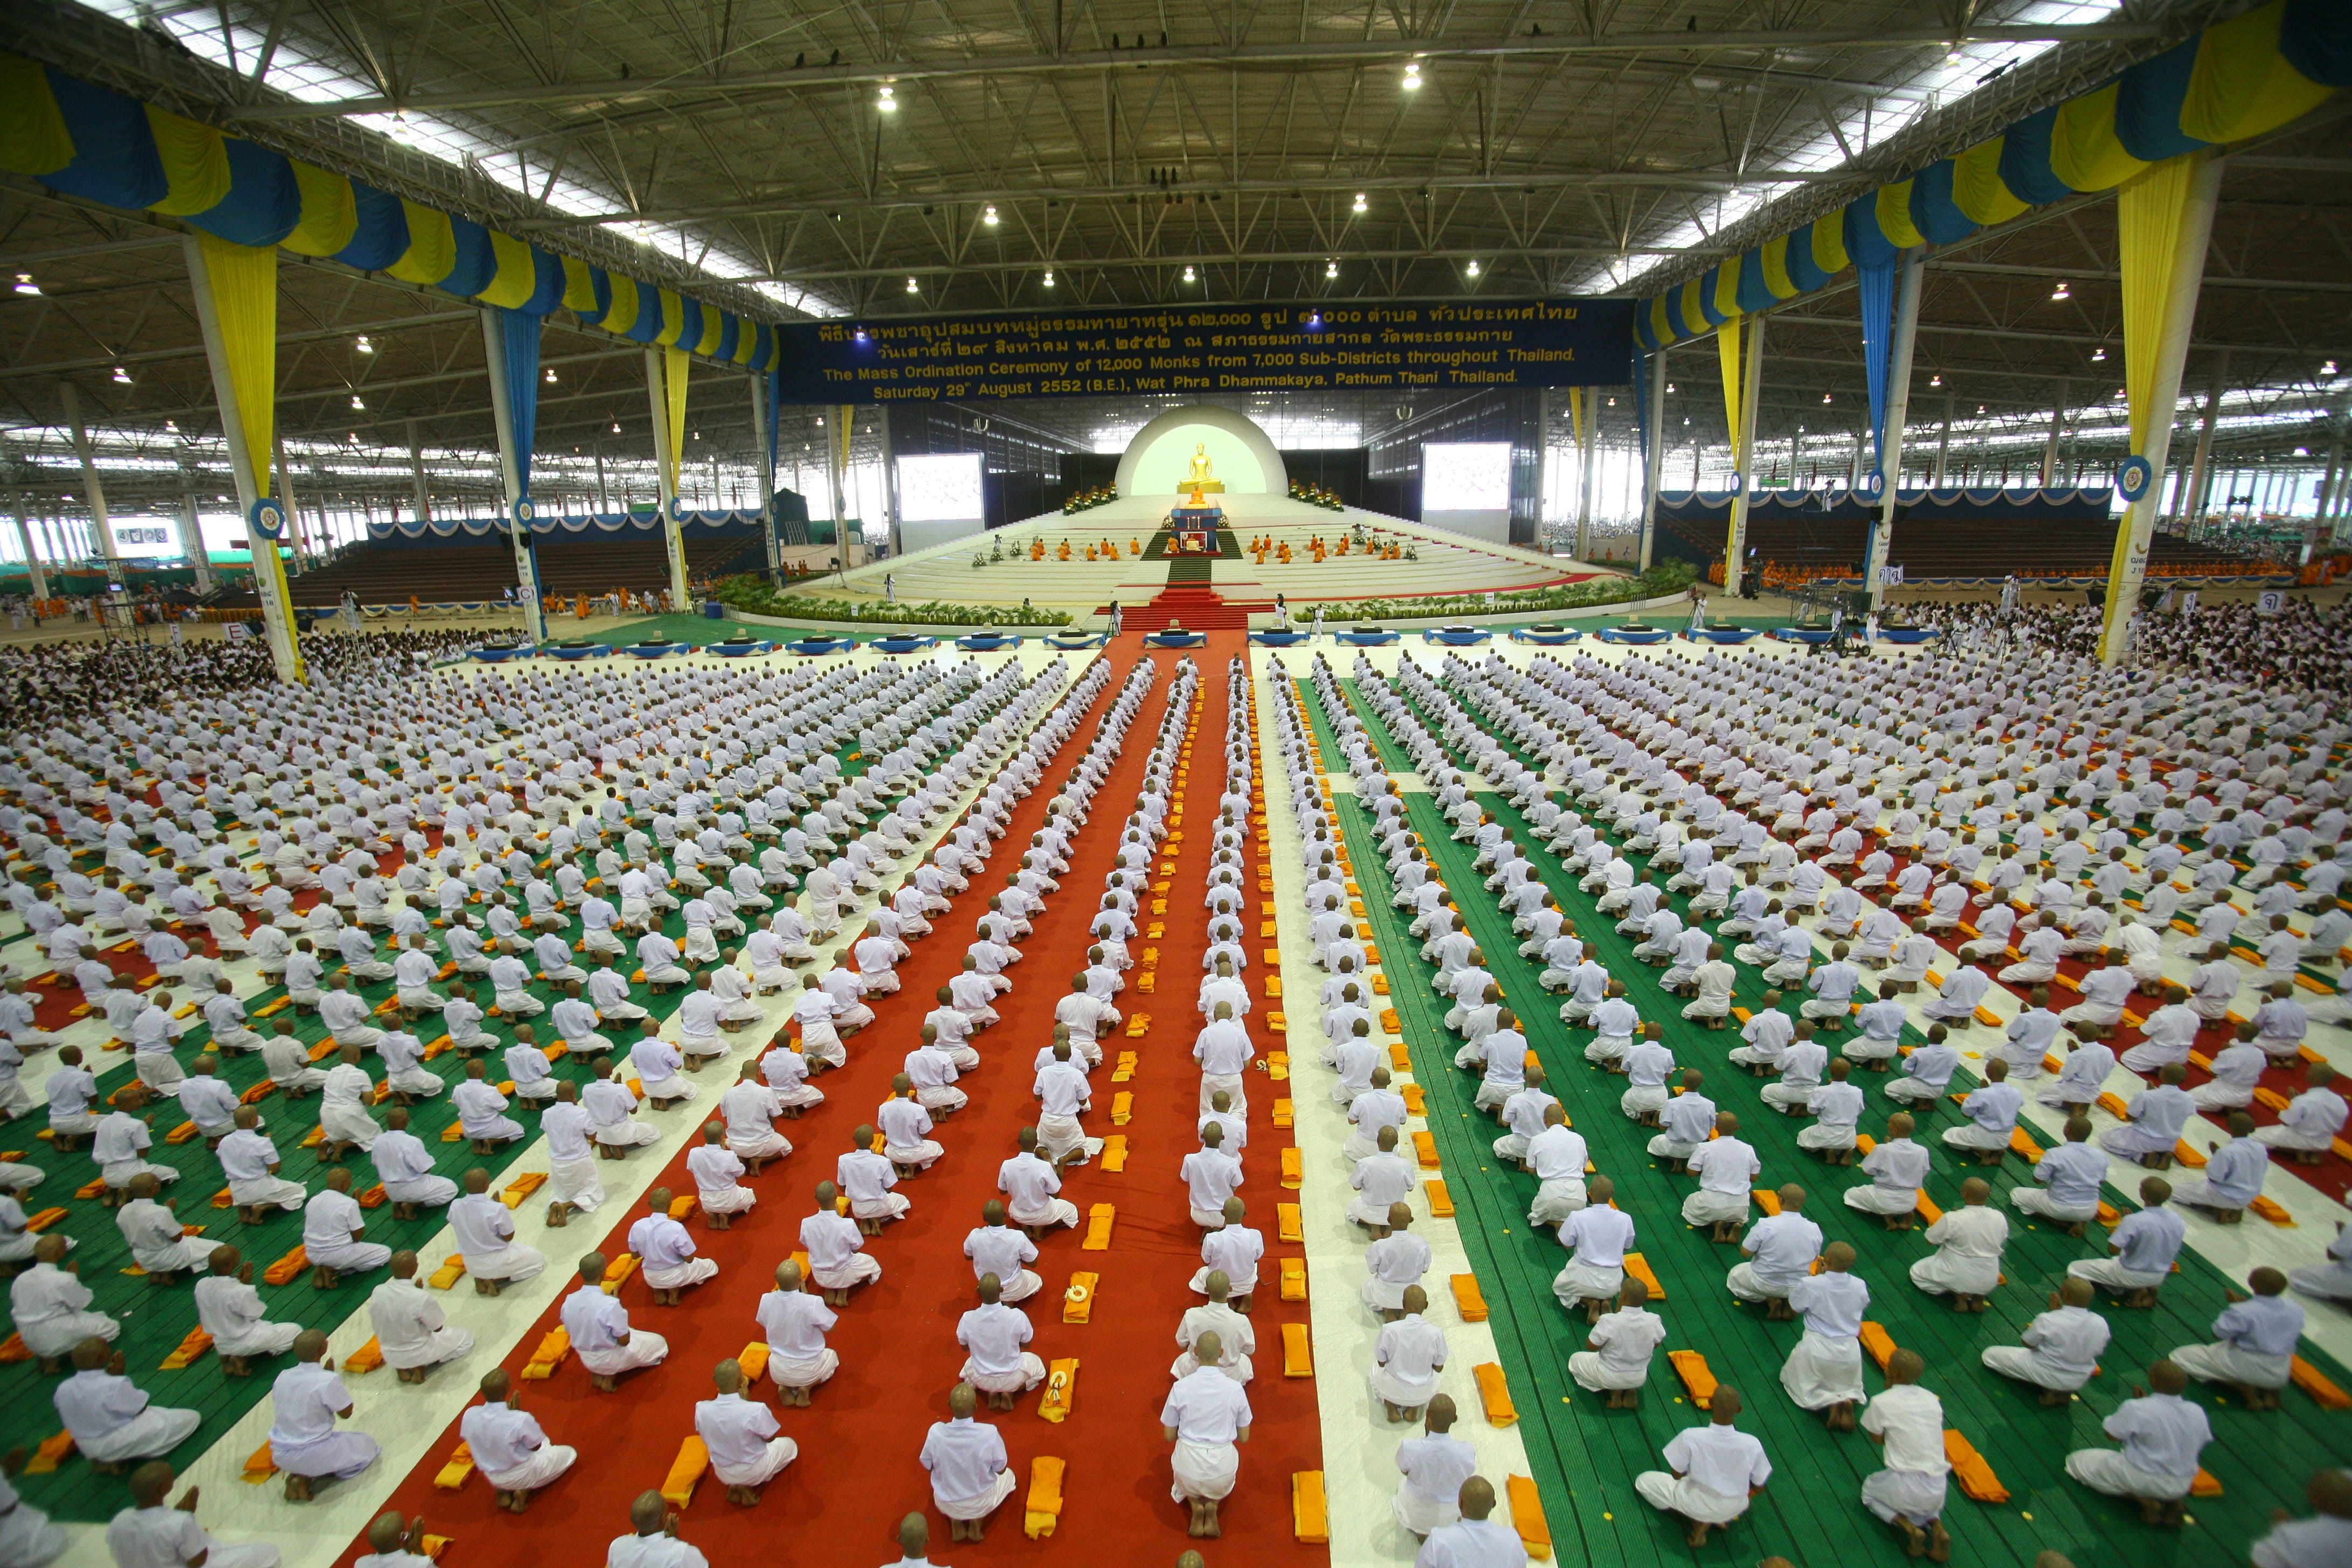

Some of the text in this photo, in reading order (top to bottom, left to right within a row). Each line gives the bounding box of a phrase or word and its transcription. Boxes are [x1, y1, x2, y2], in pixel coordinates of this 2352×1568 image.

[1261, 309, 1287, 330] รูป
[1368, 305, 1417, 323] ตำบล
[878, 327, 1513, 359] วันเสาร์ที่ ๒๙ สิงหาคม พ.ศ. ๒๕๕๒ ณ สภาธรรมกายสากล วัดพระธรรมกาย
[823, 348, 1575, 381] The Mass Ordination Ceremony of 12,000 Monks from 7,000 Sub-Districts throughout Thailand.
[873, 386, 940, 400] Saturday
[946, 382, 971, 396] 29th
[978, 382, 1033, 398] August
[1041, 380, 1082, 393] 2552
[1136, 377, 1165, 390] Wat
[1173, 376, 1210, 388] Phra
[1220, 374, 1328, 389] Dhammakaya,
[1335, 372, 1392, 385] Pathum
[1398, 371, 1439, 383] Thani
[1449, 369, 1518, 383] Thailand.
[172, 626, 178, 640] F
[228, 625, 243, 639] E
